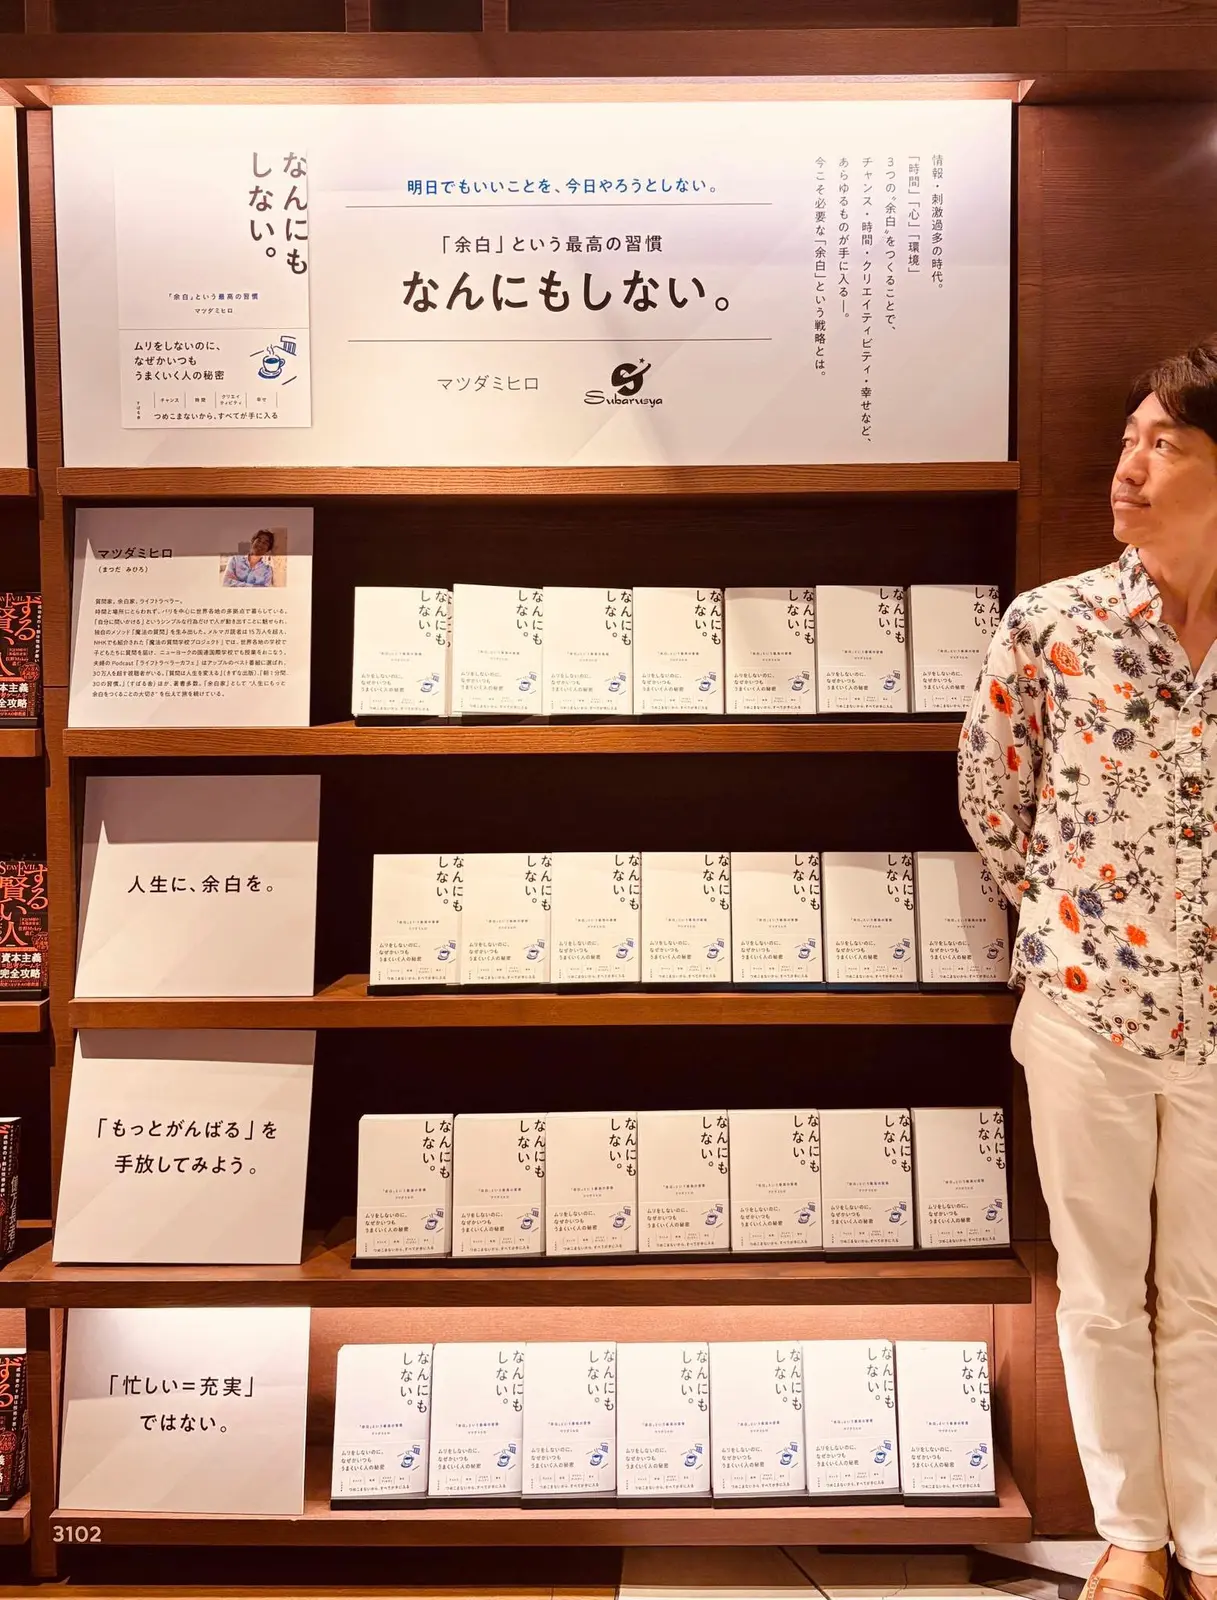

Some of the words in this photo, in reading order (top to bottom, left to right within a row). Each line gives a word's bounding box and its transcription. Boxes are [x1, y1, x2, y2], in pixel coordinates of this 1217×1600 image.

[249, 152, 276, 257] しない。
[283, 152, 308, 274] なんにも
[408, 178, 715, 195] 明日でもいいことを、今日やろうとしない。
[908, 156, 920, 272] 「時間」「心」「環境」
[932, 154, 943, 288] 情報・刺激過多の時代。
[443, 235, 662, 254] 「余白」という最高の習慣
[814, 156, 826, 376] 今こそ必要な「余白」という戦略とは。
[403, 270, 729, 312] なんにもしない。
[861, 156, 873, 442] チャンス・時間・クリエイティビティ・幸せなど、
[134, 342, 221, 351] ムリをしないのに、
[134, 356, 197, 366] なぜかいつも
[135, 371, 225, 380] うまくいく人の秘密
[437, 375, 538, 391] マツダミヒロ
[584, 390, 662, 408] Subarusya
[154, 412, 278, 420] つめこまないから、すべてが手に入る
[98, 548, 172, 559] マツダミヒロ
[419, 589, 431, 637] しない。
[435, 591, 447, 646] なんにも
[516, 589, 529, 637] しない。
[532, 590, 543, 646] なんにも
[605, 590, 618, 638] しない。
[620, 590, 632, 646] なんにも
[694, 589, 707, 637] しない。
[710, 590, 722, 645] なんにも
[787, 589, 800, 637] しない。
[803, 590, 815, 644] なんにも
[878, 588, 891, 636] しない。
[893, 589, 905, 643] なんにも
[974, 586, 987, 634] しない。
[128, 875, 273, 893] 人生に、余白を。
[436, 856, 449, 904] しない。
[452, 856, 464, 912] なんにも
[524, 855, 537, 904] しない。
[540, 855, 552, 911] なんにも
[612, 855, 626, 903] しない。
[628, 854, 640, 910] なんにも
[702, 854, 716, 903] しない。
[718, 854, 730, 911] なんにも
[793, 854, 806, 903] しない。
[808, 854, 820, 911] なんにも
[886, 854, 900, 903] しない。
[901, 854, 914, 911] なんにも
[98, 1118, 277, 1140] 「もっとがんばる」を
[423, 1120, 436, 1172] しない。
[439, 1120, 452, 1179] なんにも
[517, 1120, 531, 1171] しない。
[534, 1119, 546, 1178] なんにも
[608, 1118, 622, 1170] しない。
[625, 1117, 637, 1176] なんにも
[700, 1116, 714, 1167] しない。
[716, 1115, 728, 1175] なんにも
[792, 1115, 806, 1166] しない。
[807, 1114, 819, 1173] なんにも
[883, 1115, 897, 1165] しない。
[899, 1114, 911, 1173] なんにも
[978, 1112, 992, 1163] しない。
[993, 1111, 1005, 1170] なんにも
[115, 1155, 256, 1174] 手放してみよう。
[400, 1352, 413, 1406] しない。
[417, 1351, 429, 1413] なんにも
[495, 1351, 508, 1405] しない。
[512, 1351, 525, 1412] なんにも
[587, 1350, 600, 1403] しない。
[603, 1350, 615, 1411] なんにも
[680, 1350, 694, 1404] しない。
[696, 1350, 708, 1412] なんにも
[774, 1349, 788, 1403] しない。
[790, 1349, 802, 1410] なんにも
[866, 1347, 881, 1401] しない。
[881, 1347, 894, 1409] なんにも
[961, 1349, 976, 1404] しない。
[976, 1349, 990, 1412] なんにも
[140, 1414, 227, 1433] ではない。
[53, 1526, 101, 1542] 3102
